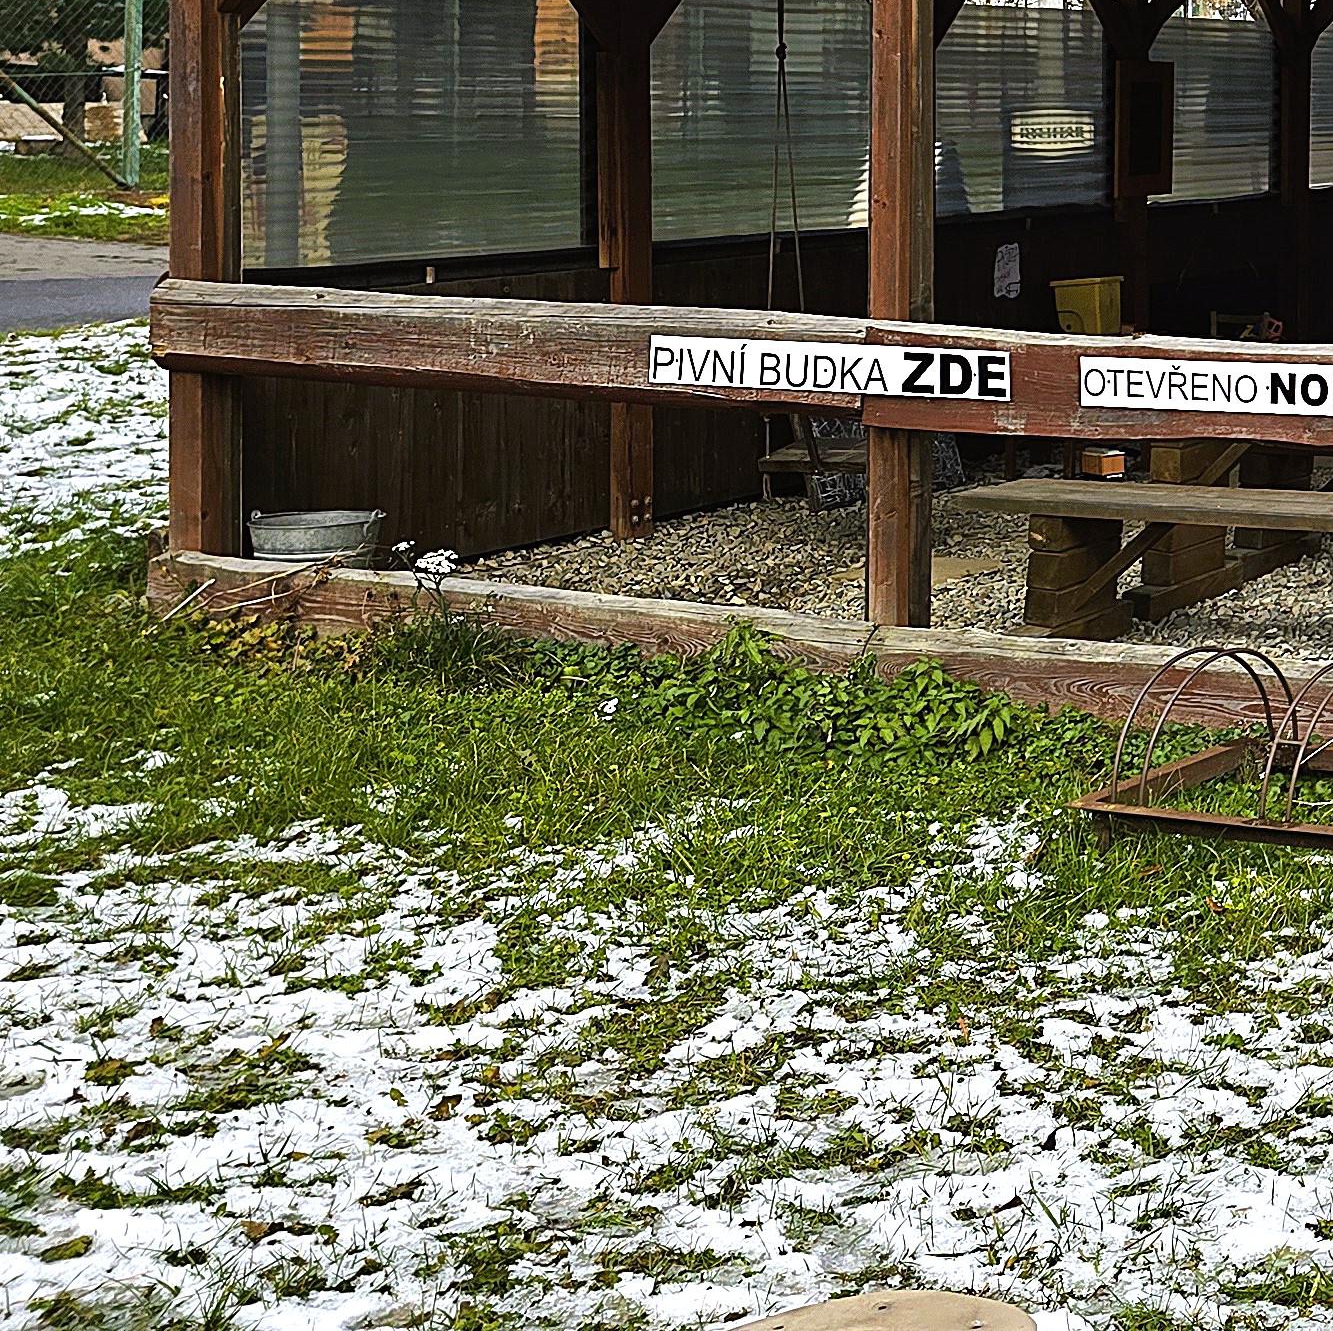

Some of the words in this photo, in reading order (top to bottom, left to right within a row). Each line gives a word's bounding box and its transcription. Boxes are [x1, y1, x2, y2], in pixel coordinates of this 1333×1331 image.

[652, 343, 746, 385] PIVNÍ
[759, 353, 889, 392] BUDKA
[901, 352, 1007, 398] ZDE
[1084, 365, 1258, 404] OTEVŘENO
